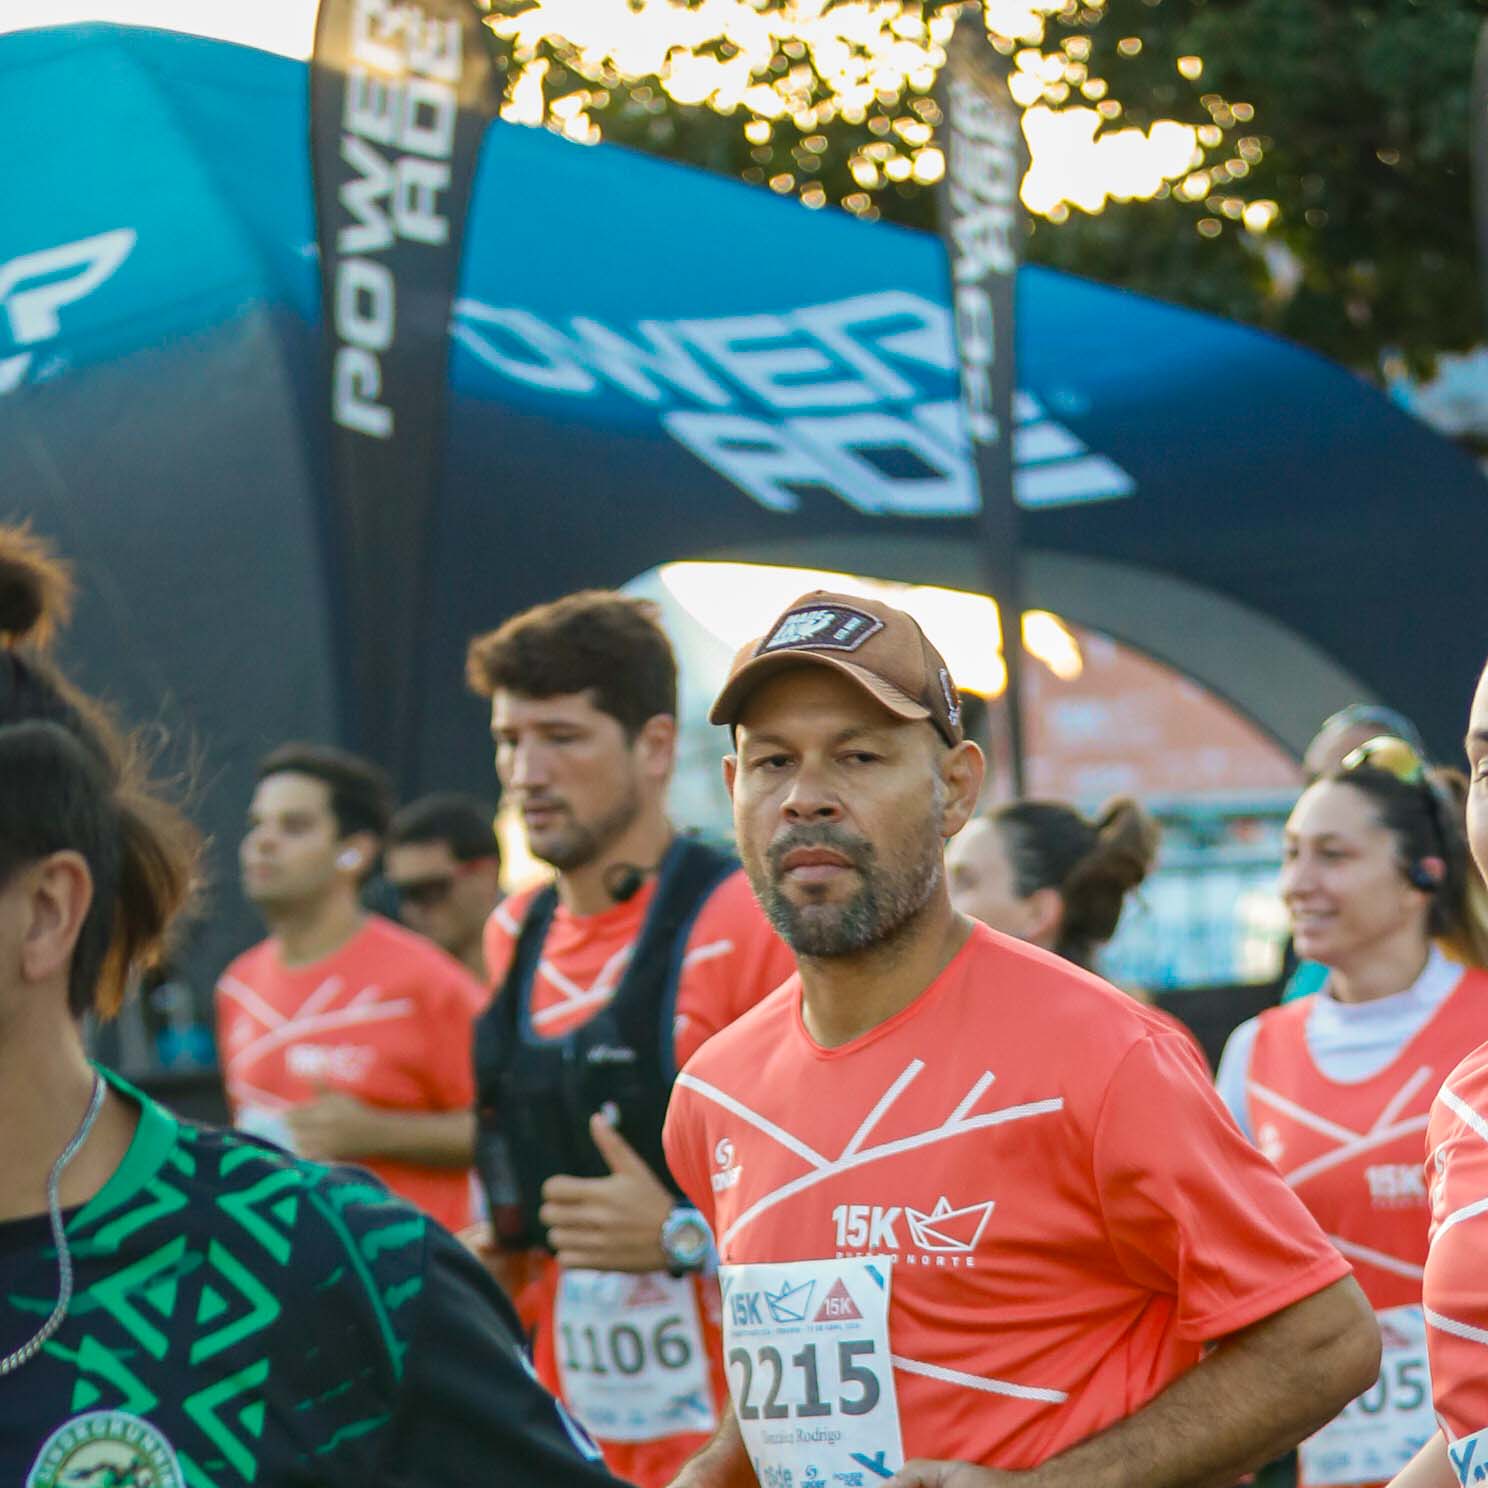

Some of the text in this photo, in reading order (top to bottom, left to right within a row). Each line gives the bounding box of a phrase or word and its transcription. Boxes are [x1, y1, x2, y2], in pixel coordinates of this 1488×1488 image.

[393, 8, 463, 247] ADE
[331, 0, 409, 440] POWER
[452, 290, 957, 407] OWER
[832, 1204, 901, 1249] 15K
[906, 1254, 976, 1267] NORTE
[731, 1291, 763, 1327] 15K
[824, 1297, 852, 1317] 15K
[561, 1314, 692, 1375] 1106
[729, 1339, 881, 1420] 2215
